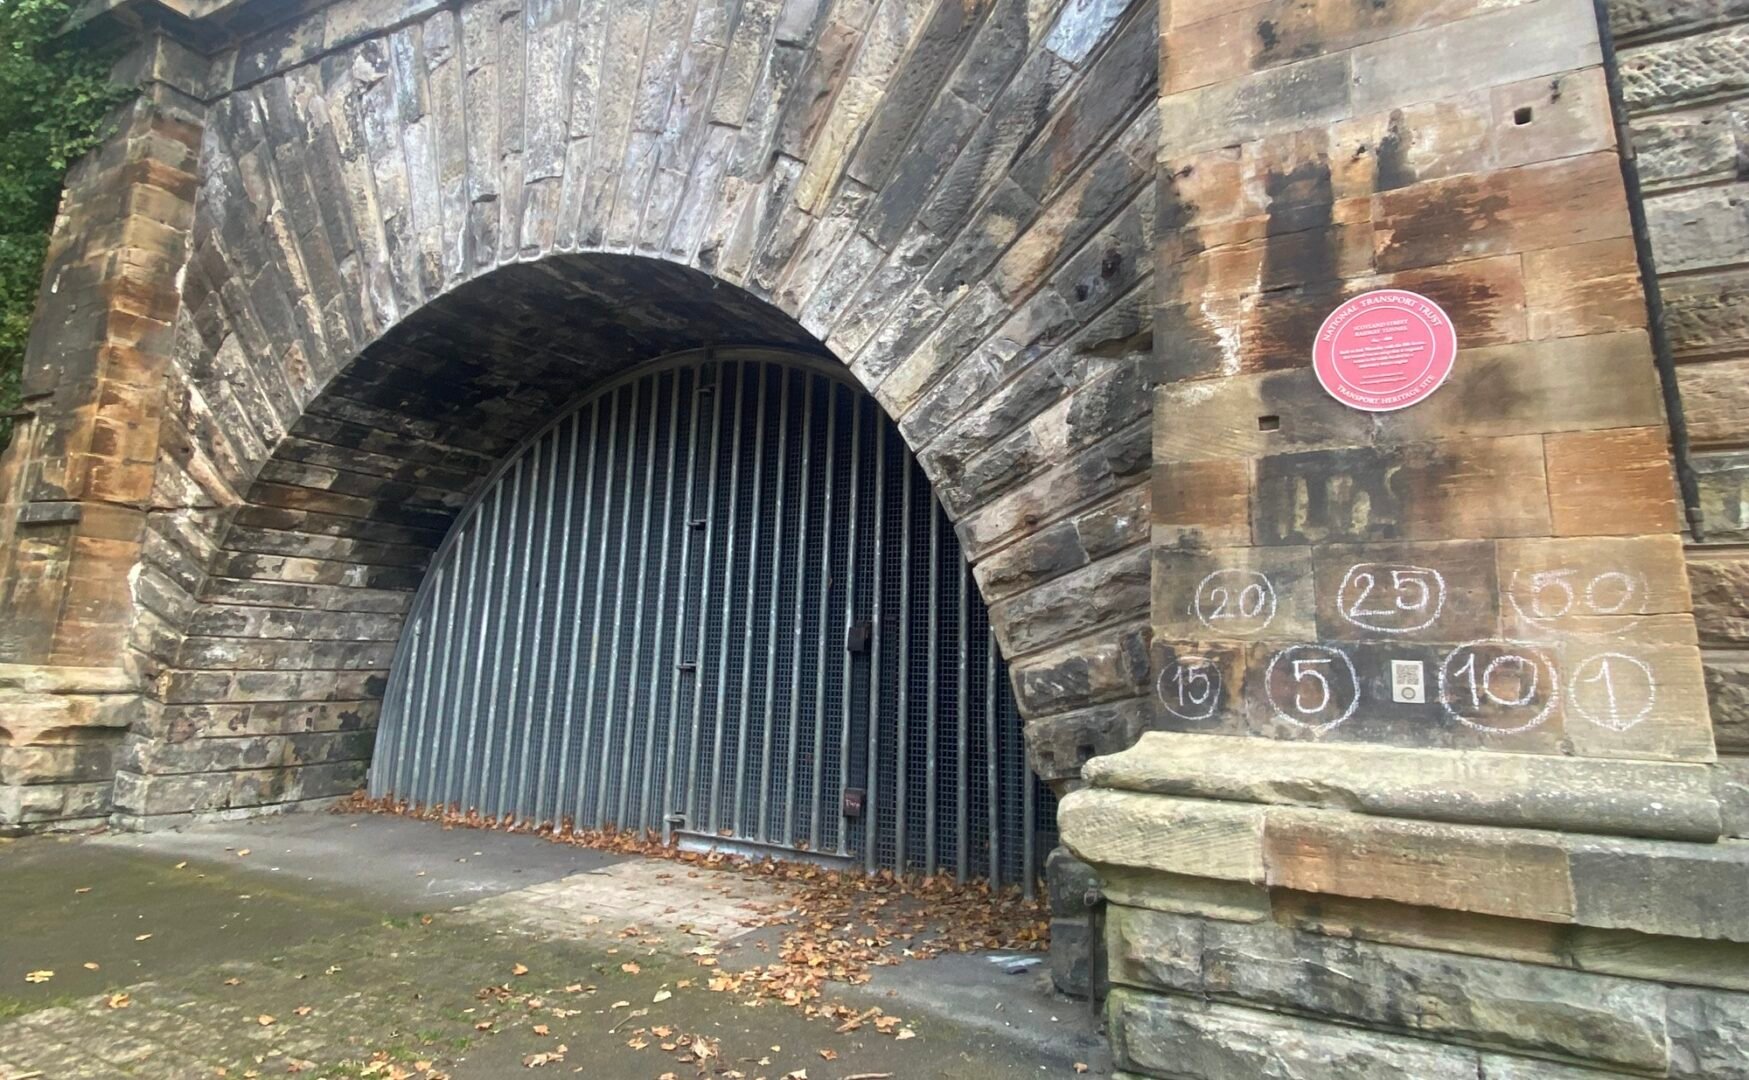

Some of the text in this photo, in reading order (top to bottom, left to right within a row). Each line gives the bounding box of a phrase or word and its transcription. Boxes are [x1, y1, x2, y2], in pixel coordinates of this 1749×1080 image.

[1323, 295, 1442, 341] NATIONAL TRANSPORT TRUST
[1337, 384, 1380, 403] TRANSPORT
[1381, 387, 1420, 403] HERITAGE
[1421, 374, 1435, 388] SITE
[1210, 582, 1266, 620] 20
[1350, 570, 1430, 617] 25
[1531, 569, 1635, 618] 50
[1172, 665, 1211, 706] 15
[1292, 658, 1330, 714] 5
[1454, 653, 1538, 712] 10
[1584, 659, 1618, 728] 1
